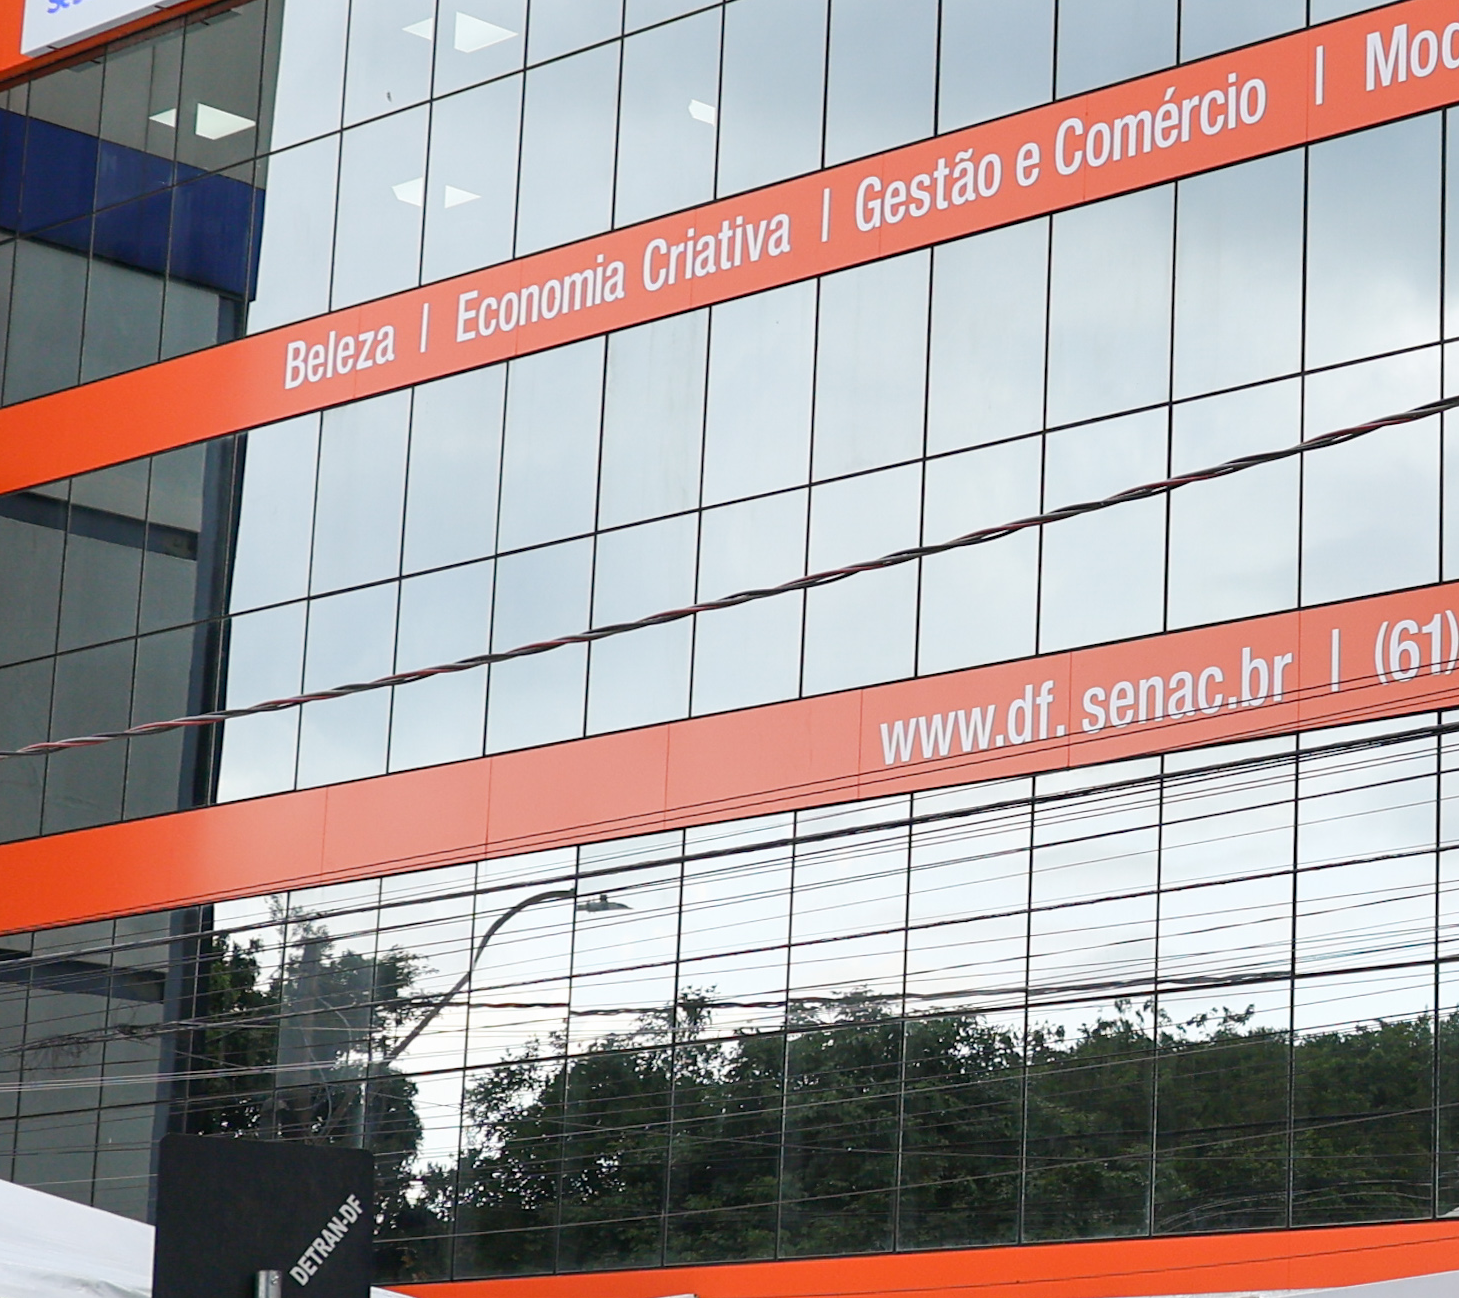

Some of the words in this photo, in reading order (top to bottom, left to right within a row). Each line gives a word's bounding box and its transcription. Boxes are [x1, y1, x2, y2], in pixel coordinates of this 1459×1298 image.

[283, 317, 396, 391] Beleza
[455, 253, 626, 345] Economia
[640, 205, 791, 294] Criativa
[854, 145, 1002, 234] Gestão
[1015, 141, 1041, 187] e
[1053, 70, 1268, 177] Comércio
[1081, 645, 1294, 735] senac.br
[289, 1193, 365, 1288] DETRAN-DF
